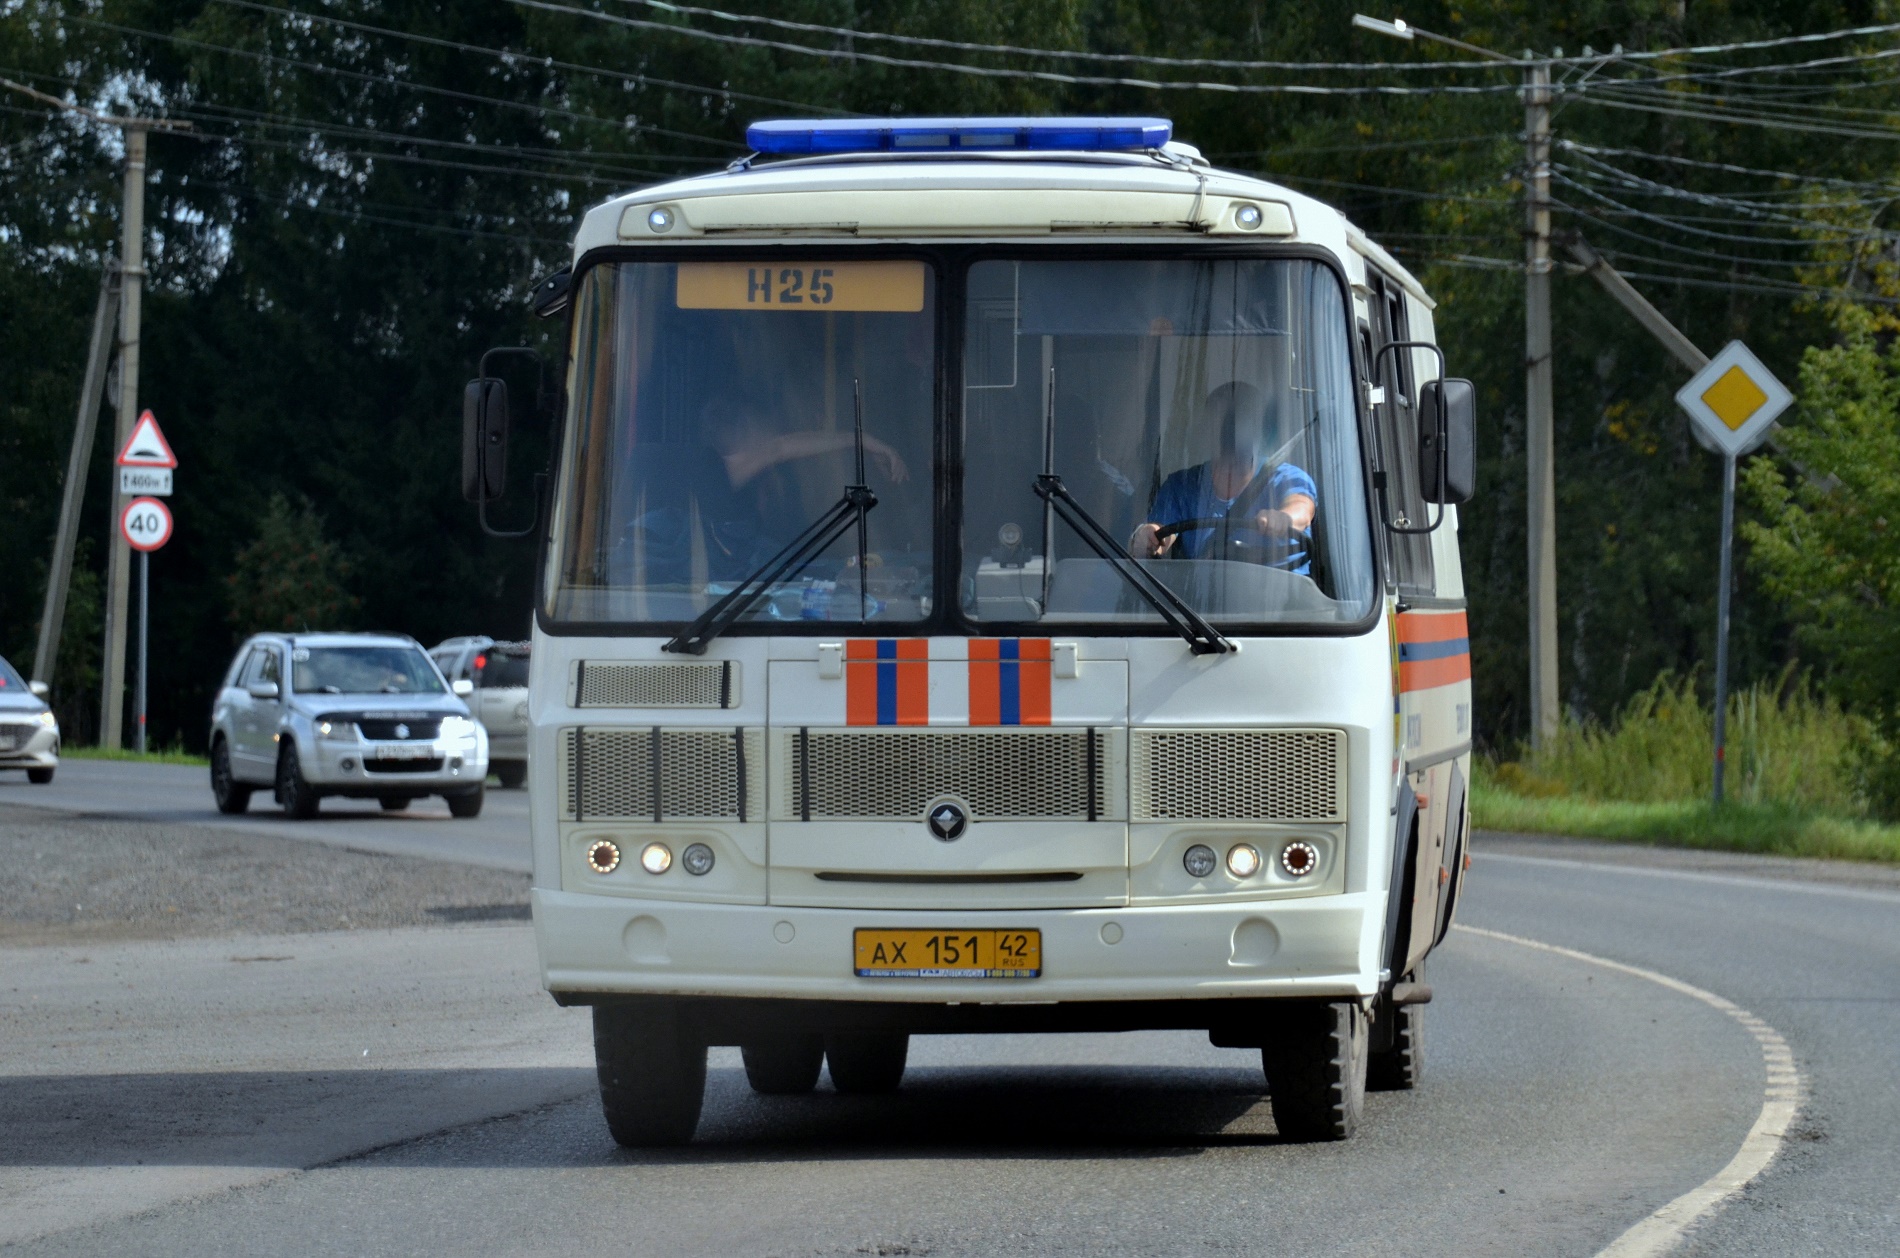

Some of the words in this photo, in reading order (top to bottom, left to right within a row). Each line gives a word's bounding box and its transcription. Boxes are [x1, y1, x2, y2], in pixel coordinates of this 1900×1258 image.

[747, 268, 834, 304] H25
[130, 513, 159, 533] 40
[925, 935, 978, 964] 151
[999, 934, 1028, 957] 42
[1002, 958, 1025, 967] RUS
